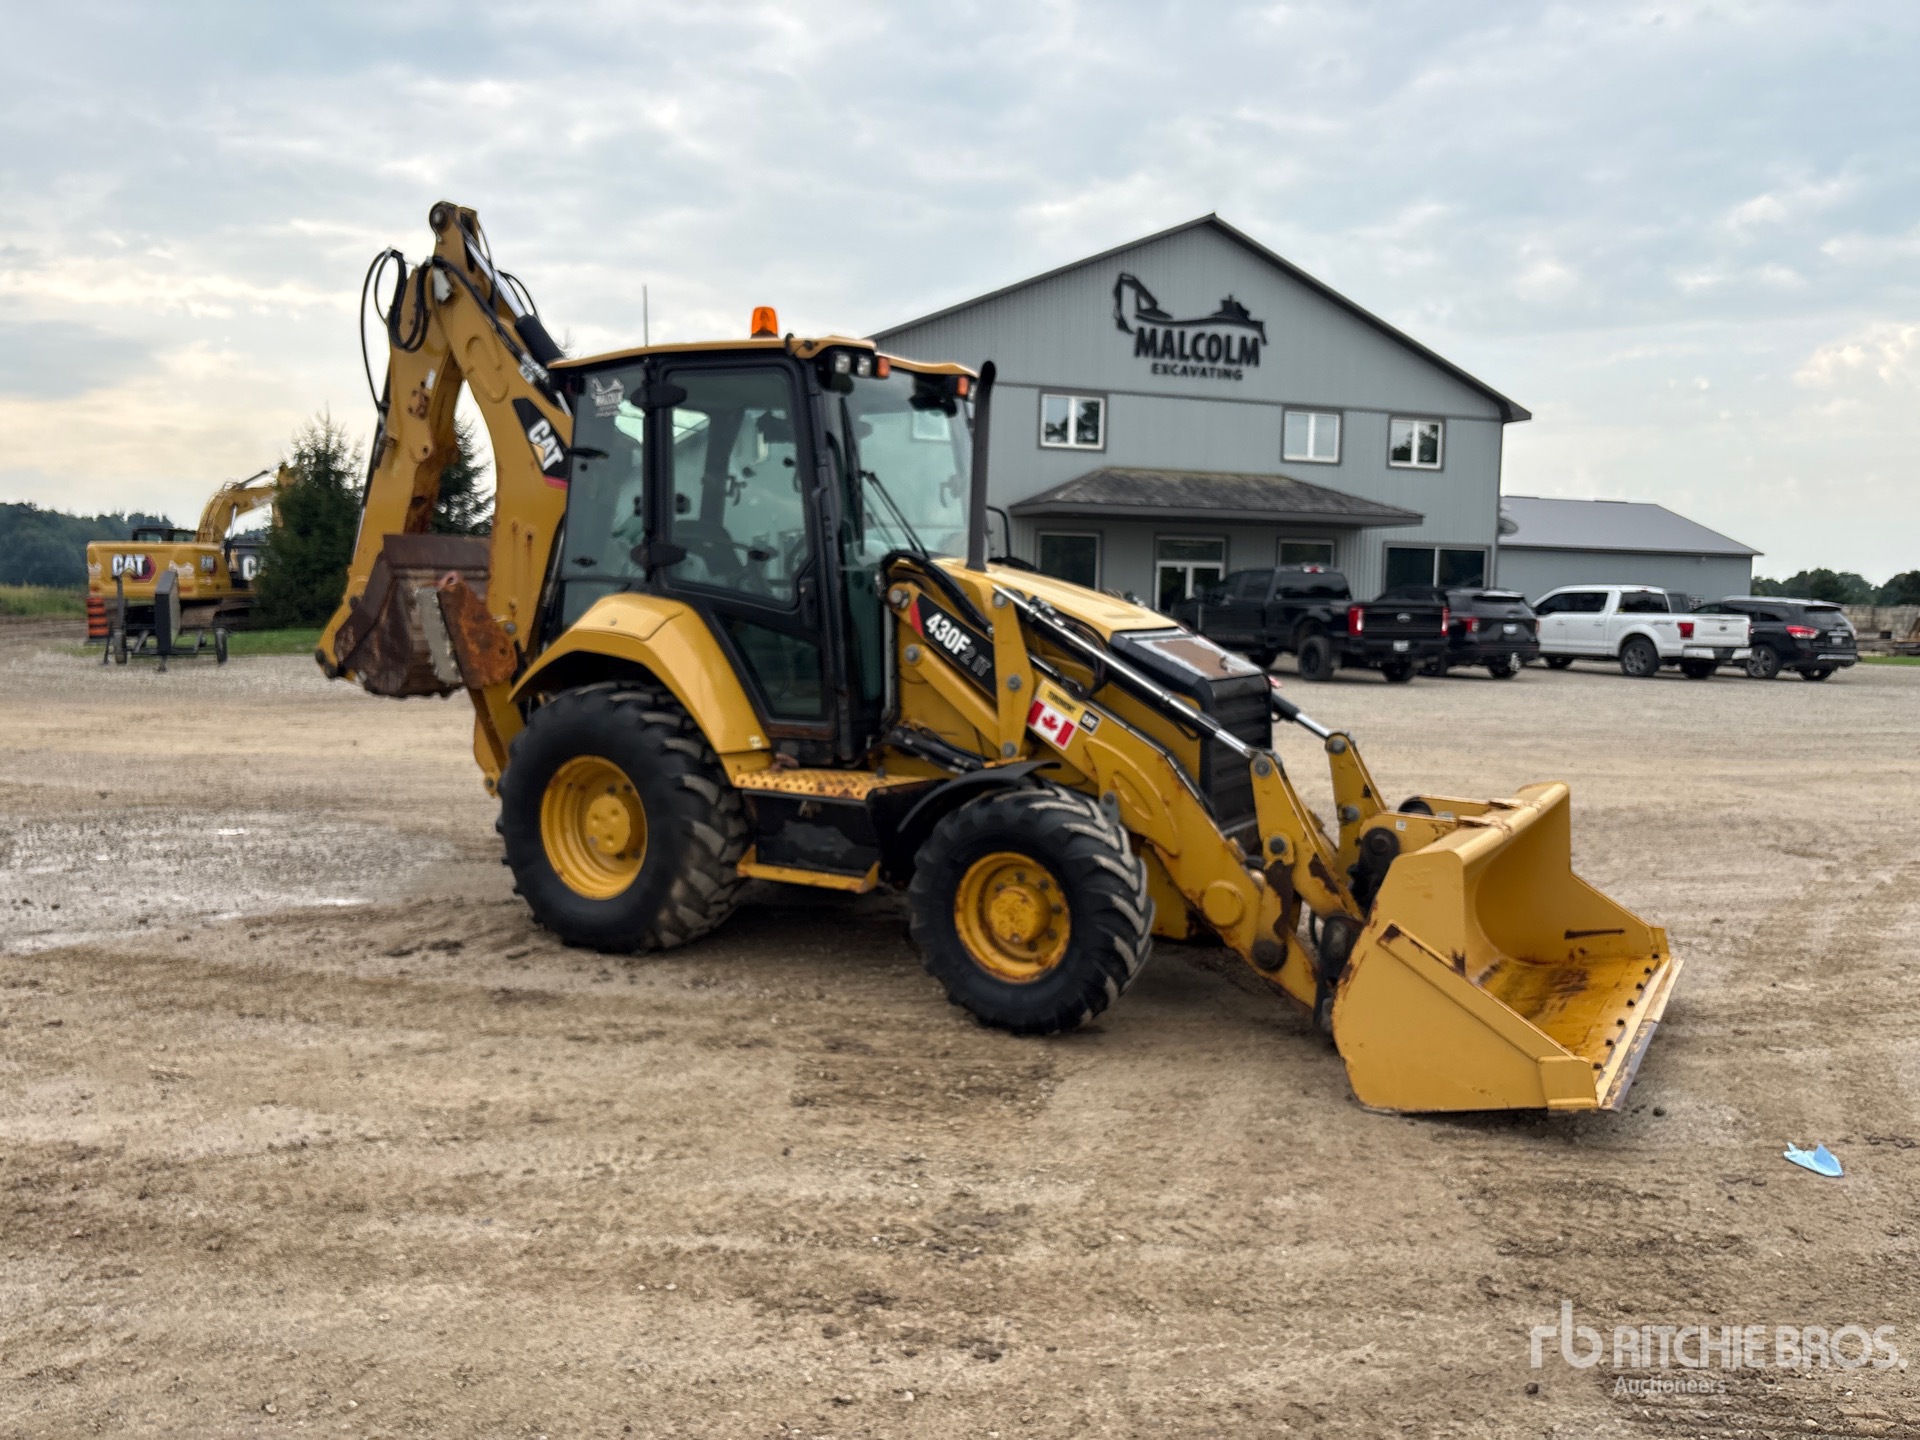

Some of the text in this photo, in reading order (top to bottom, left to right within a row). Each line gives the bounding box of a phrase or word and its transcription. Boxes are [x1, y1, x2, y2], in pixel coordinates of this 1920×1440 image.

[1135, 327, 1260, 368] MALCOLM
[1151, 362, 1243, 381] EXCAVATING
[528, 418, 564, 471] CAT
[112, 554, 146, 577] CAT
